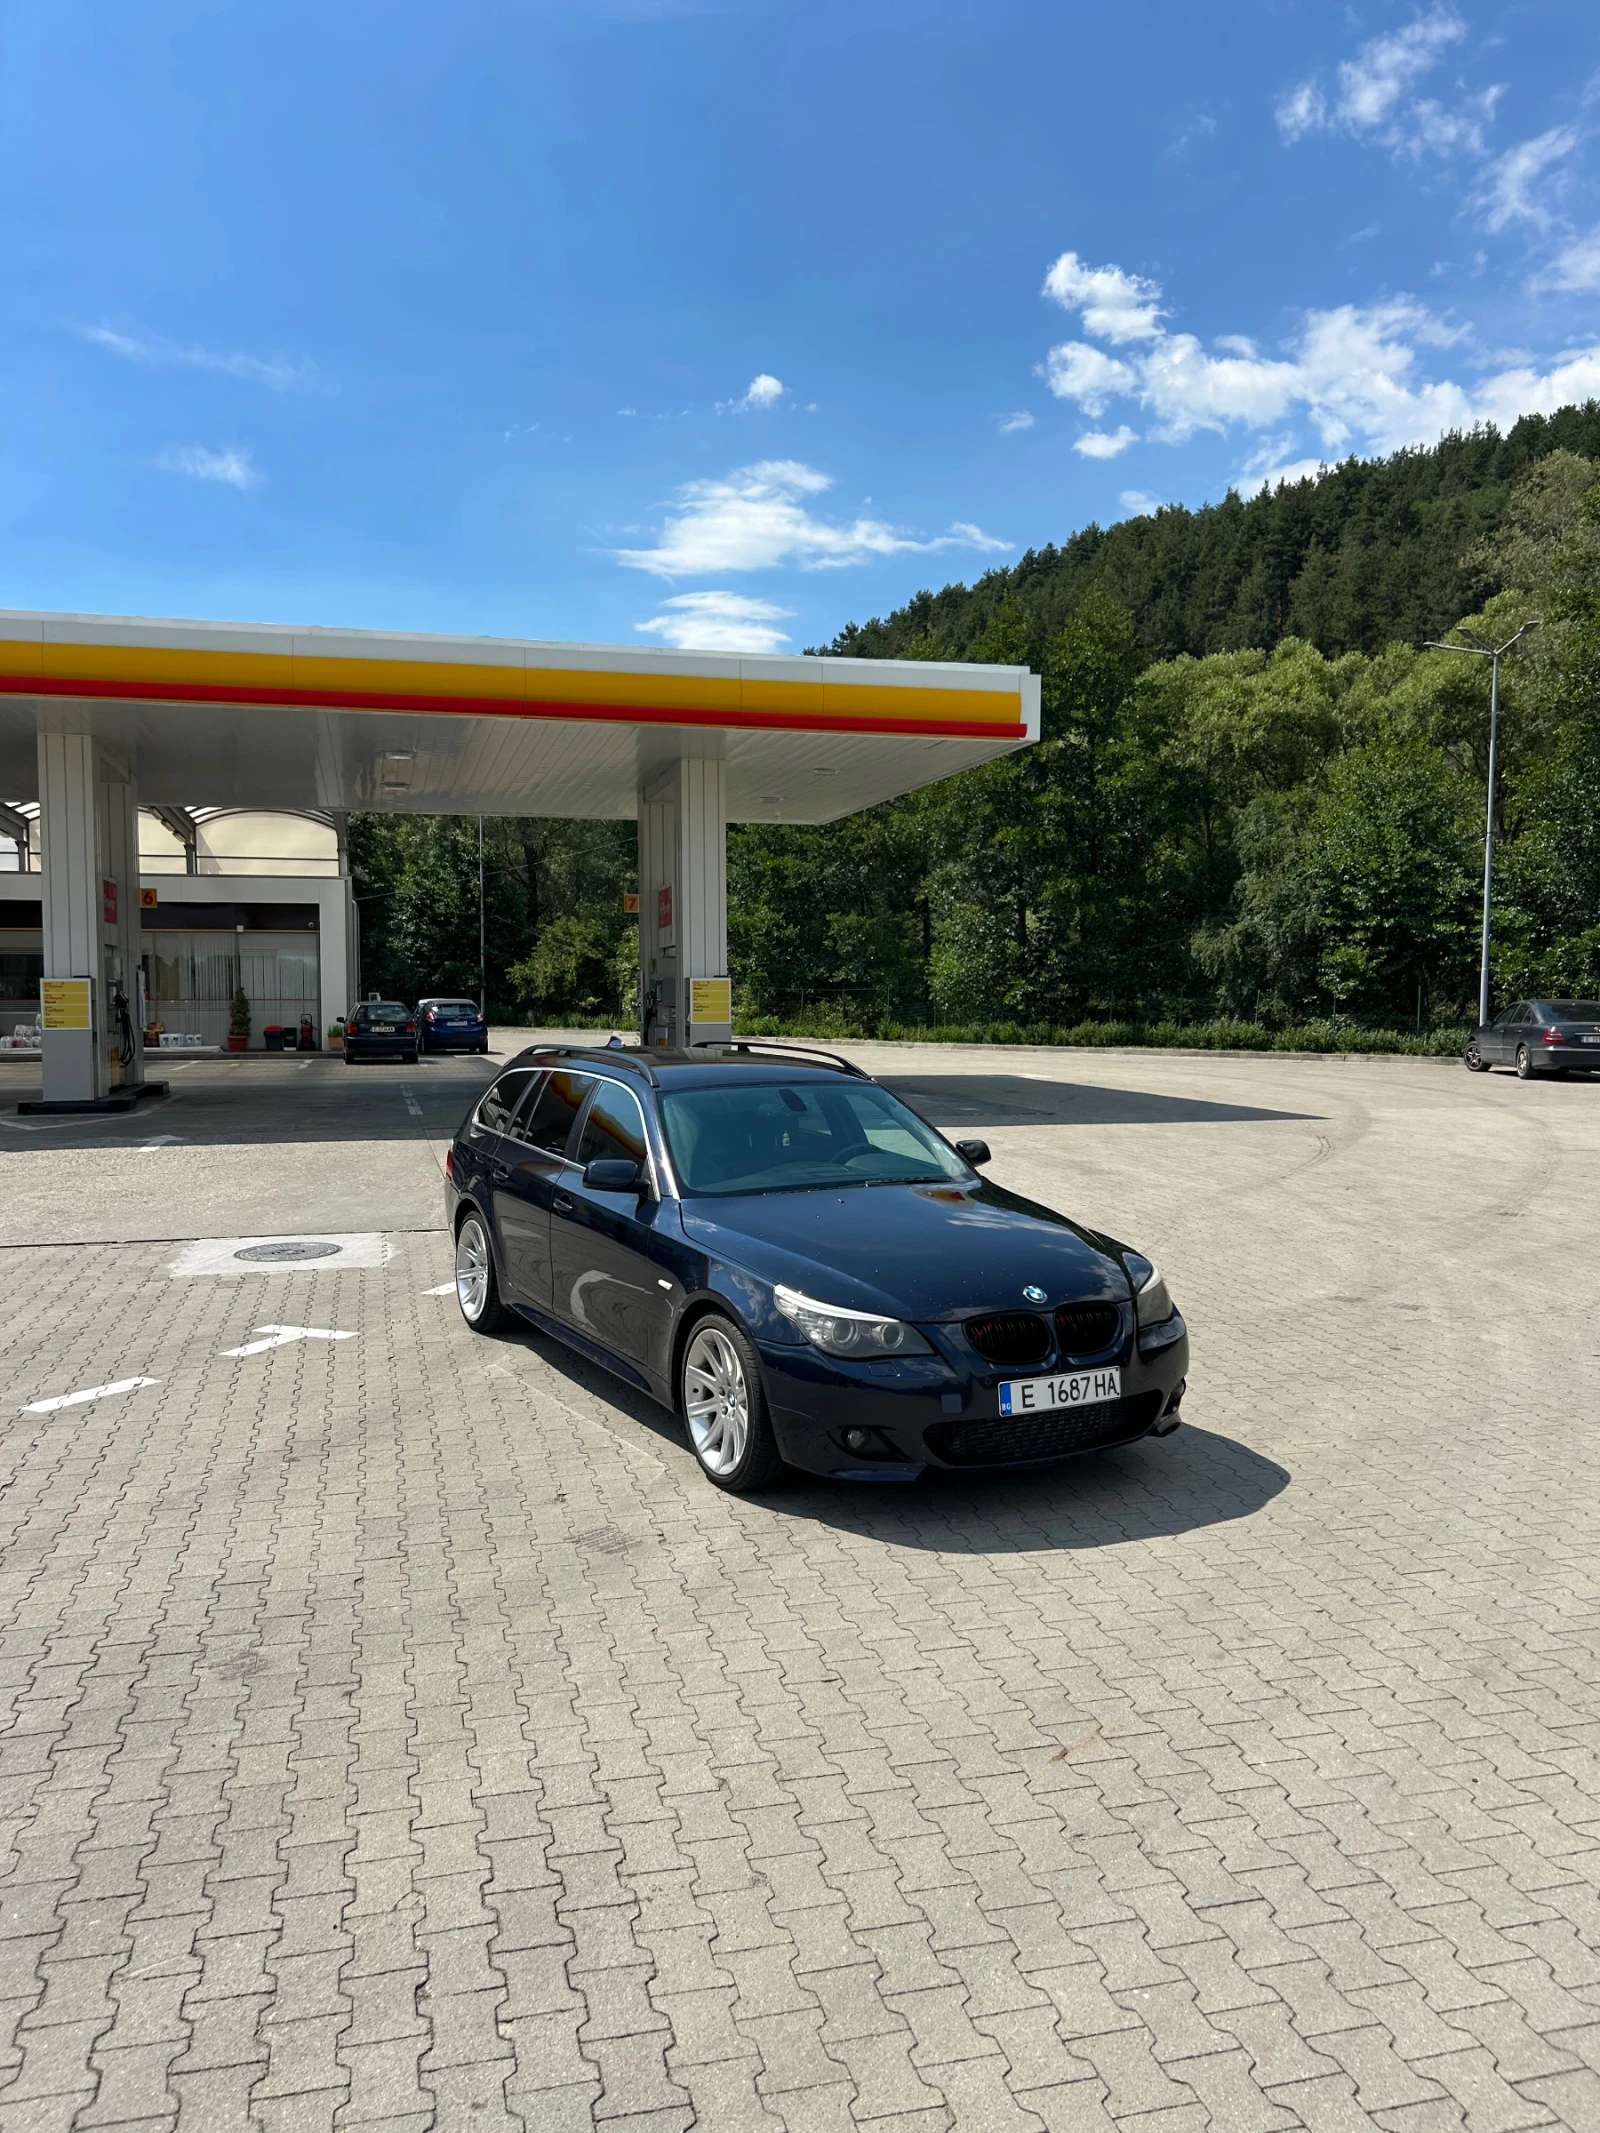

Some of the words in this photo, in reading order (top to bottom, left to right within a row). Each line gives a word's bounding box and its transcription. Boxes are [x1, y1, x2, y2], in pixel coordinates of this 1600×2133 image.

[143, 892, 153, 905] 6
[628, 898, 637, 910] 7
[1021, 1384, 1035, 1409] E
[1047, 1376, 1091, 1404] 1687
[1094, 1372, 1118, 1398] HA
[1001, 1402, 1012, 1411] BG
